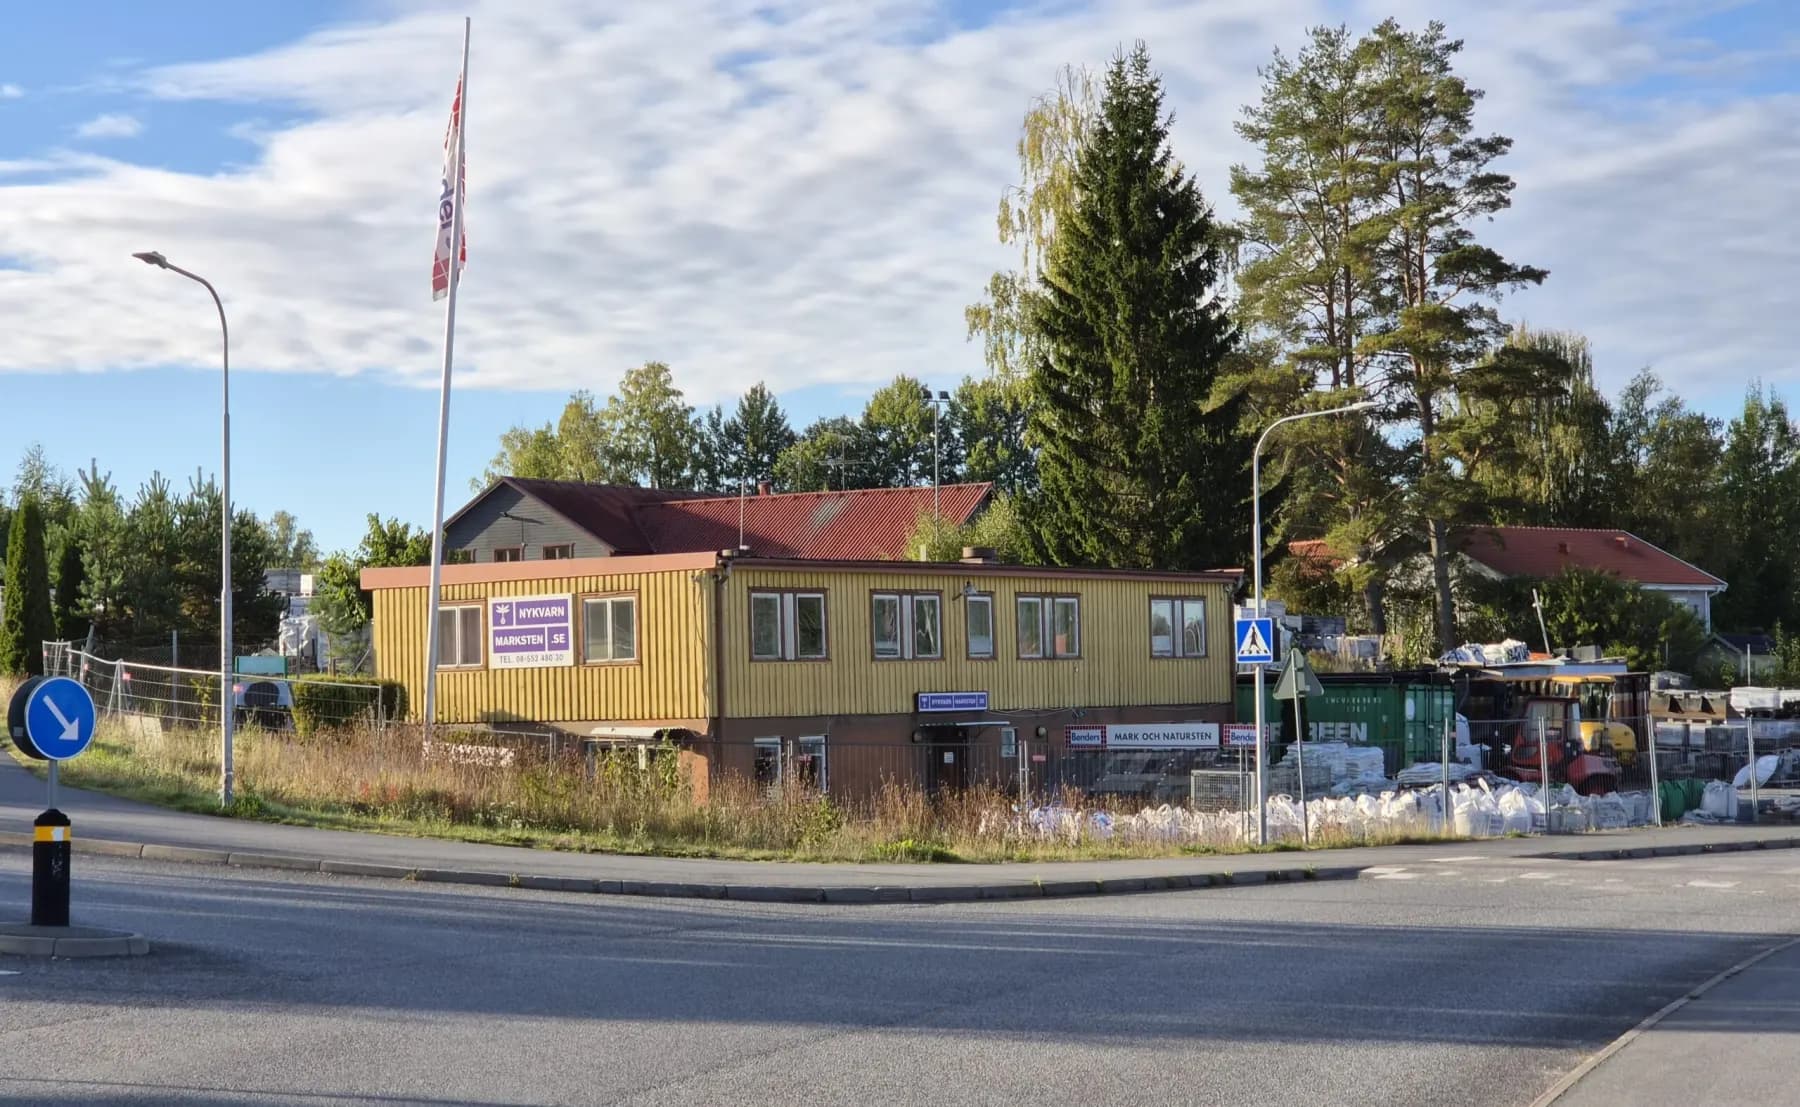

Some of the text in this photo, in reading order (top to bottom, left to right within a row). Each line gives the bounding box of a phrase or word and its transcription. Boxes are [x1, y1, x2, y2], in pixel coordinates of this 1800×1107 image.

[519, 606, 565, 619] NYKVARN
[495, 634, 544, 646] MARKSTEN
[1071, 731, 1212, 742] Benders MARK OCH NATURSTEN
